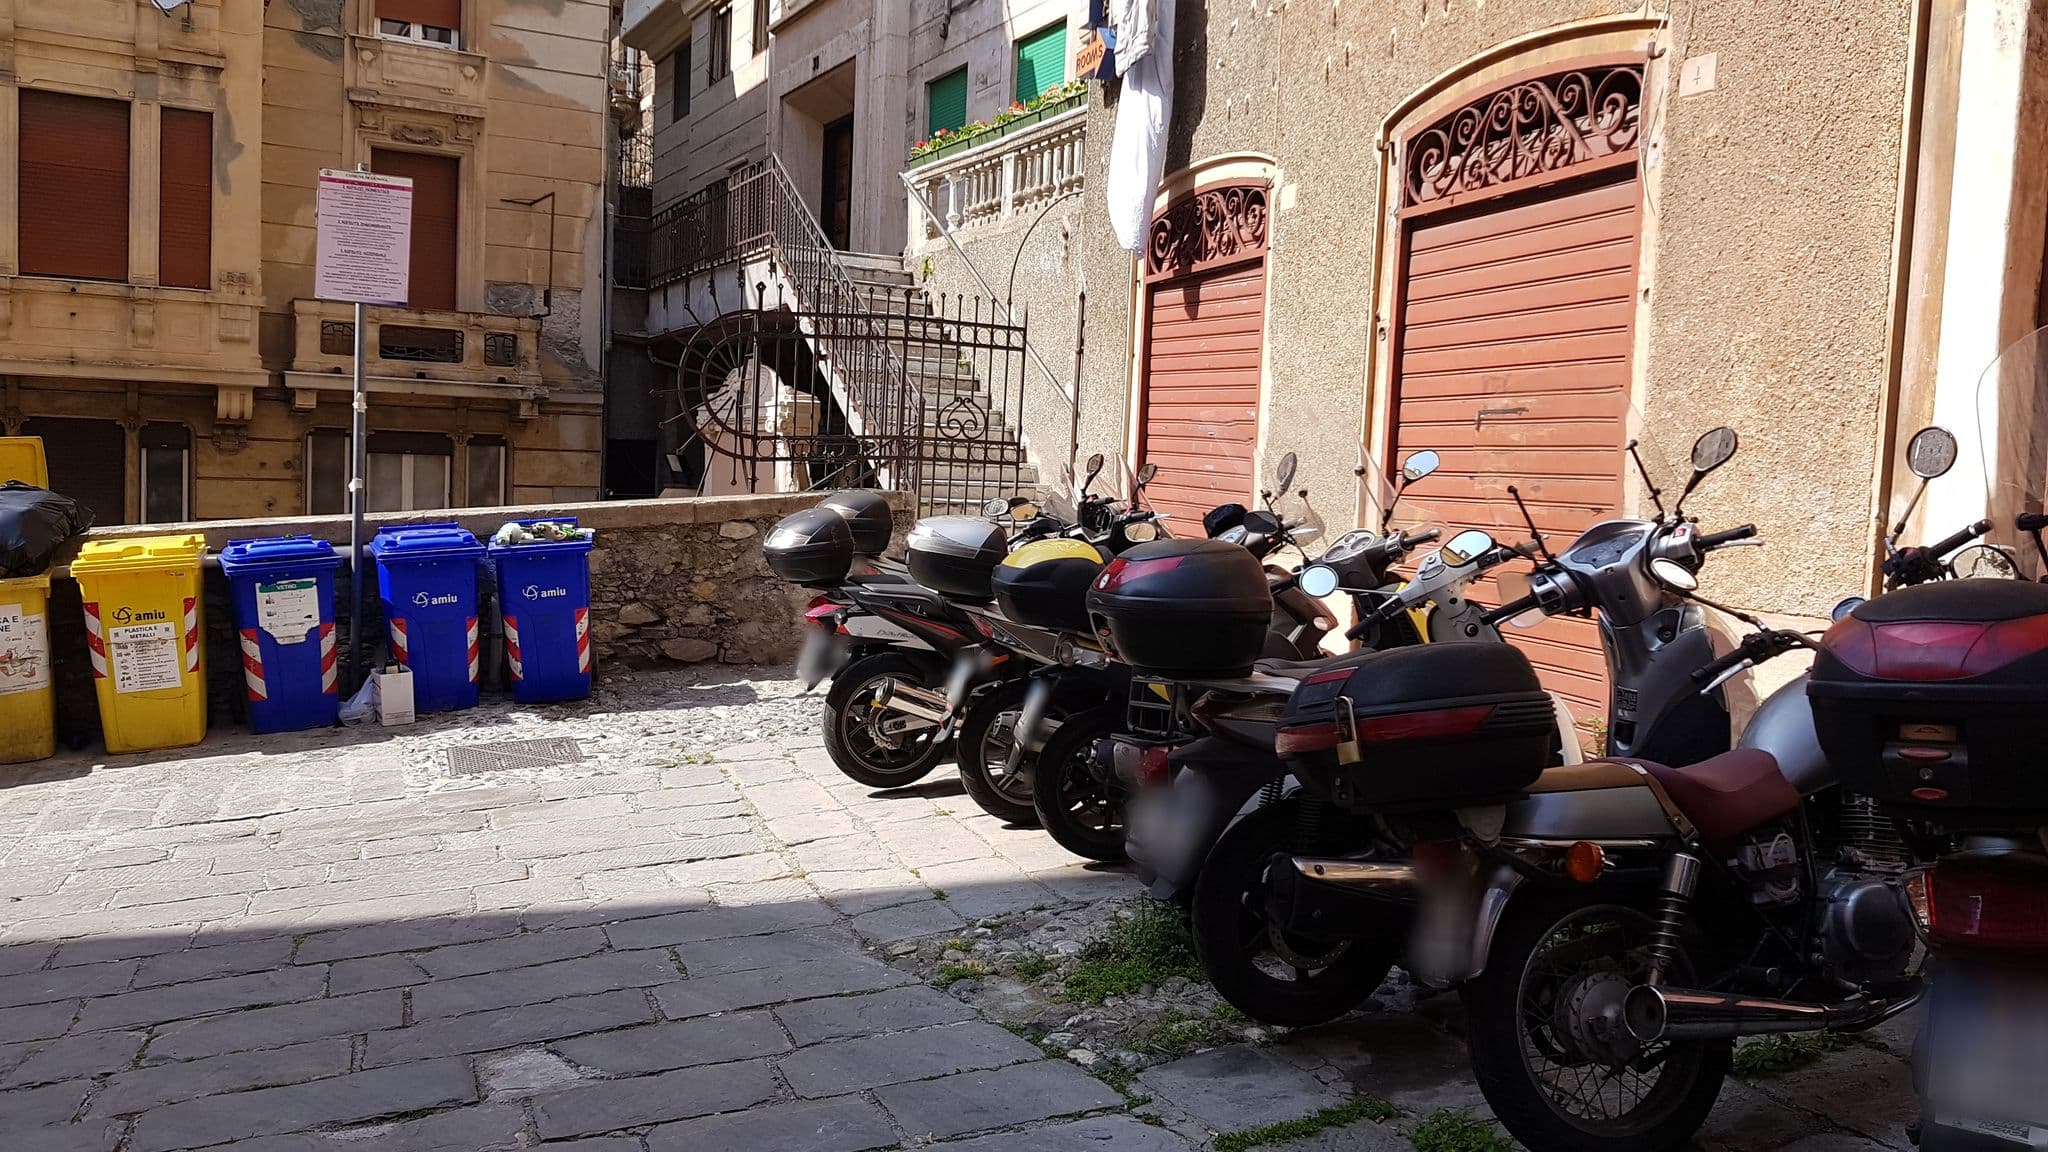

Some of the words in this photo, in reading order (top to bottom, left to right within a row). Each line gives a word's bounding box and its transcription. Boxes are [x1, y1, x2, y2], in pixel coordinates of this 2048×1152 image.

[1076, 44, 1104, 72] ROOMS
[540, 587, 567, 598] amiu
[431, 594, 458, 605] amiu
[12, 615, 19, 623] E
[135, 609, 166, 621] amiu
[124, 626, 152, 634] PLASTICA
[129, 632, 156, 640] METALLI
